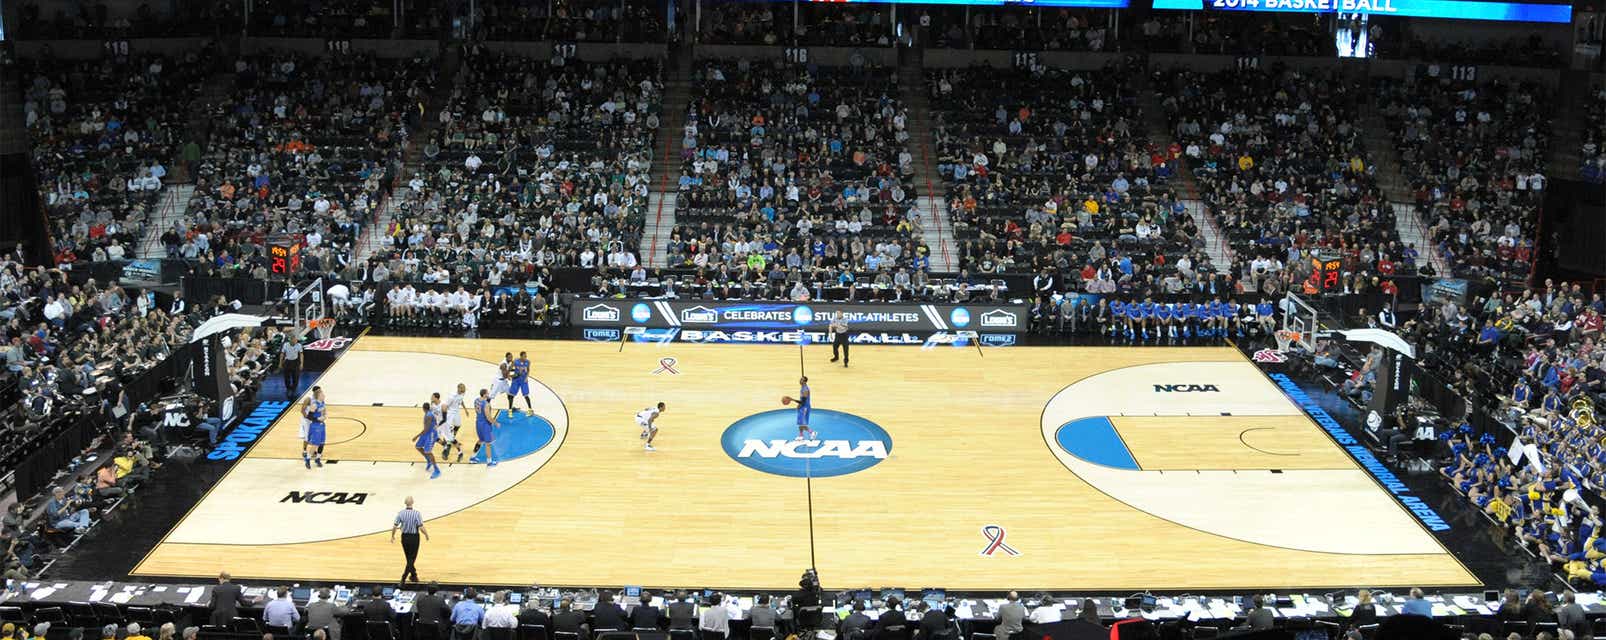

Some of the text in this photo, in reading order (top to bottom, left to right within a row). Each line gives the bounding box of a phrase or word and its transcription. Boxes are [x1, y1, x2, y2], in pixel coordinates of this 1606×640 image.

[1213, 0, 1397, 12] 2014 BASKETBALL
[1452, 65, 1476, 80] 113
[272, 257, 285, 273] 29
[1324, 272, 1338, 288] 29
[723, 311, 791, 320] CELEBRATES
[814, 312, 919, 322] STUENT-ATHLETES
[681, 331, 923, 343] BASKETALL
[1153, 384, 1219, 392] NCAA
[207, 401, 290, 460] SPOKANE
[738, 439, 888, 459] NCAA
[1345, 446, 1410, 494] MEMORIAL
[1398, 495, 1450, 531] ARENA
[280, 491, 368, 505] NCAA
